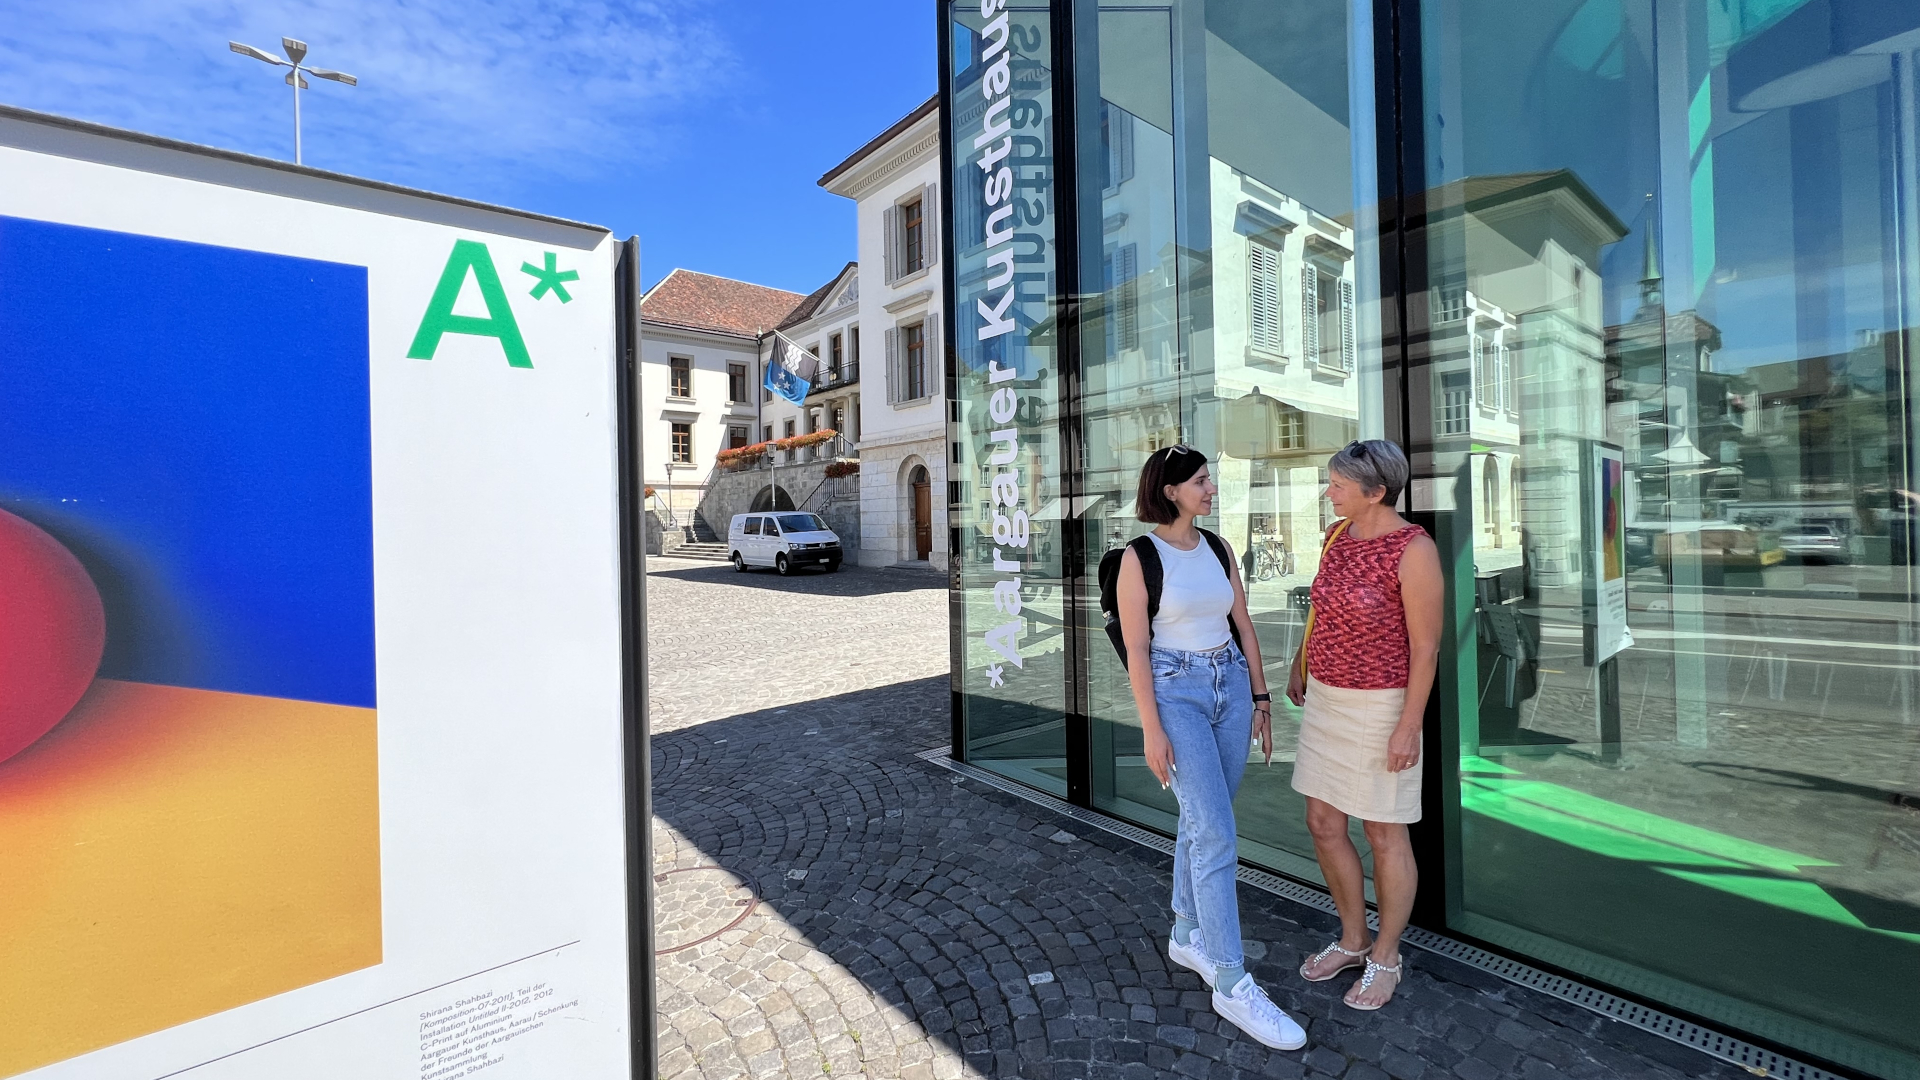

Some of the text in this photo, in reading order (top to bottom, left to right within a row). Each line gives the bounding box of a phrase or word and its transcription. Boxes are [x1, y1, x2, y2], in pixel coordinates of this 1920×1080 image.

[419, 989, 493, 1020] Shirana Shahbazi
[517, 986, 531, 996] Teil
[533, 982, 546, 992] der
[420, 1020, 466, 1041] Installation
[468, 1006, 500, 1023] Untitled
[533, 988, 554, 1001] 2012
[420, 1014, 513, 1051] C-Print auf Aluminium
[420, 1043, 460, 1061] Aargauer
[462, 1026, 507, 1045] Kunsthaus,
[420, 1021, 544, 1072] der Freunde der Aargauischen
[421, 1052, 488, 1080] Kunstsammlung
[466, 1053, 505, 1075] Shahbazi
